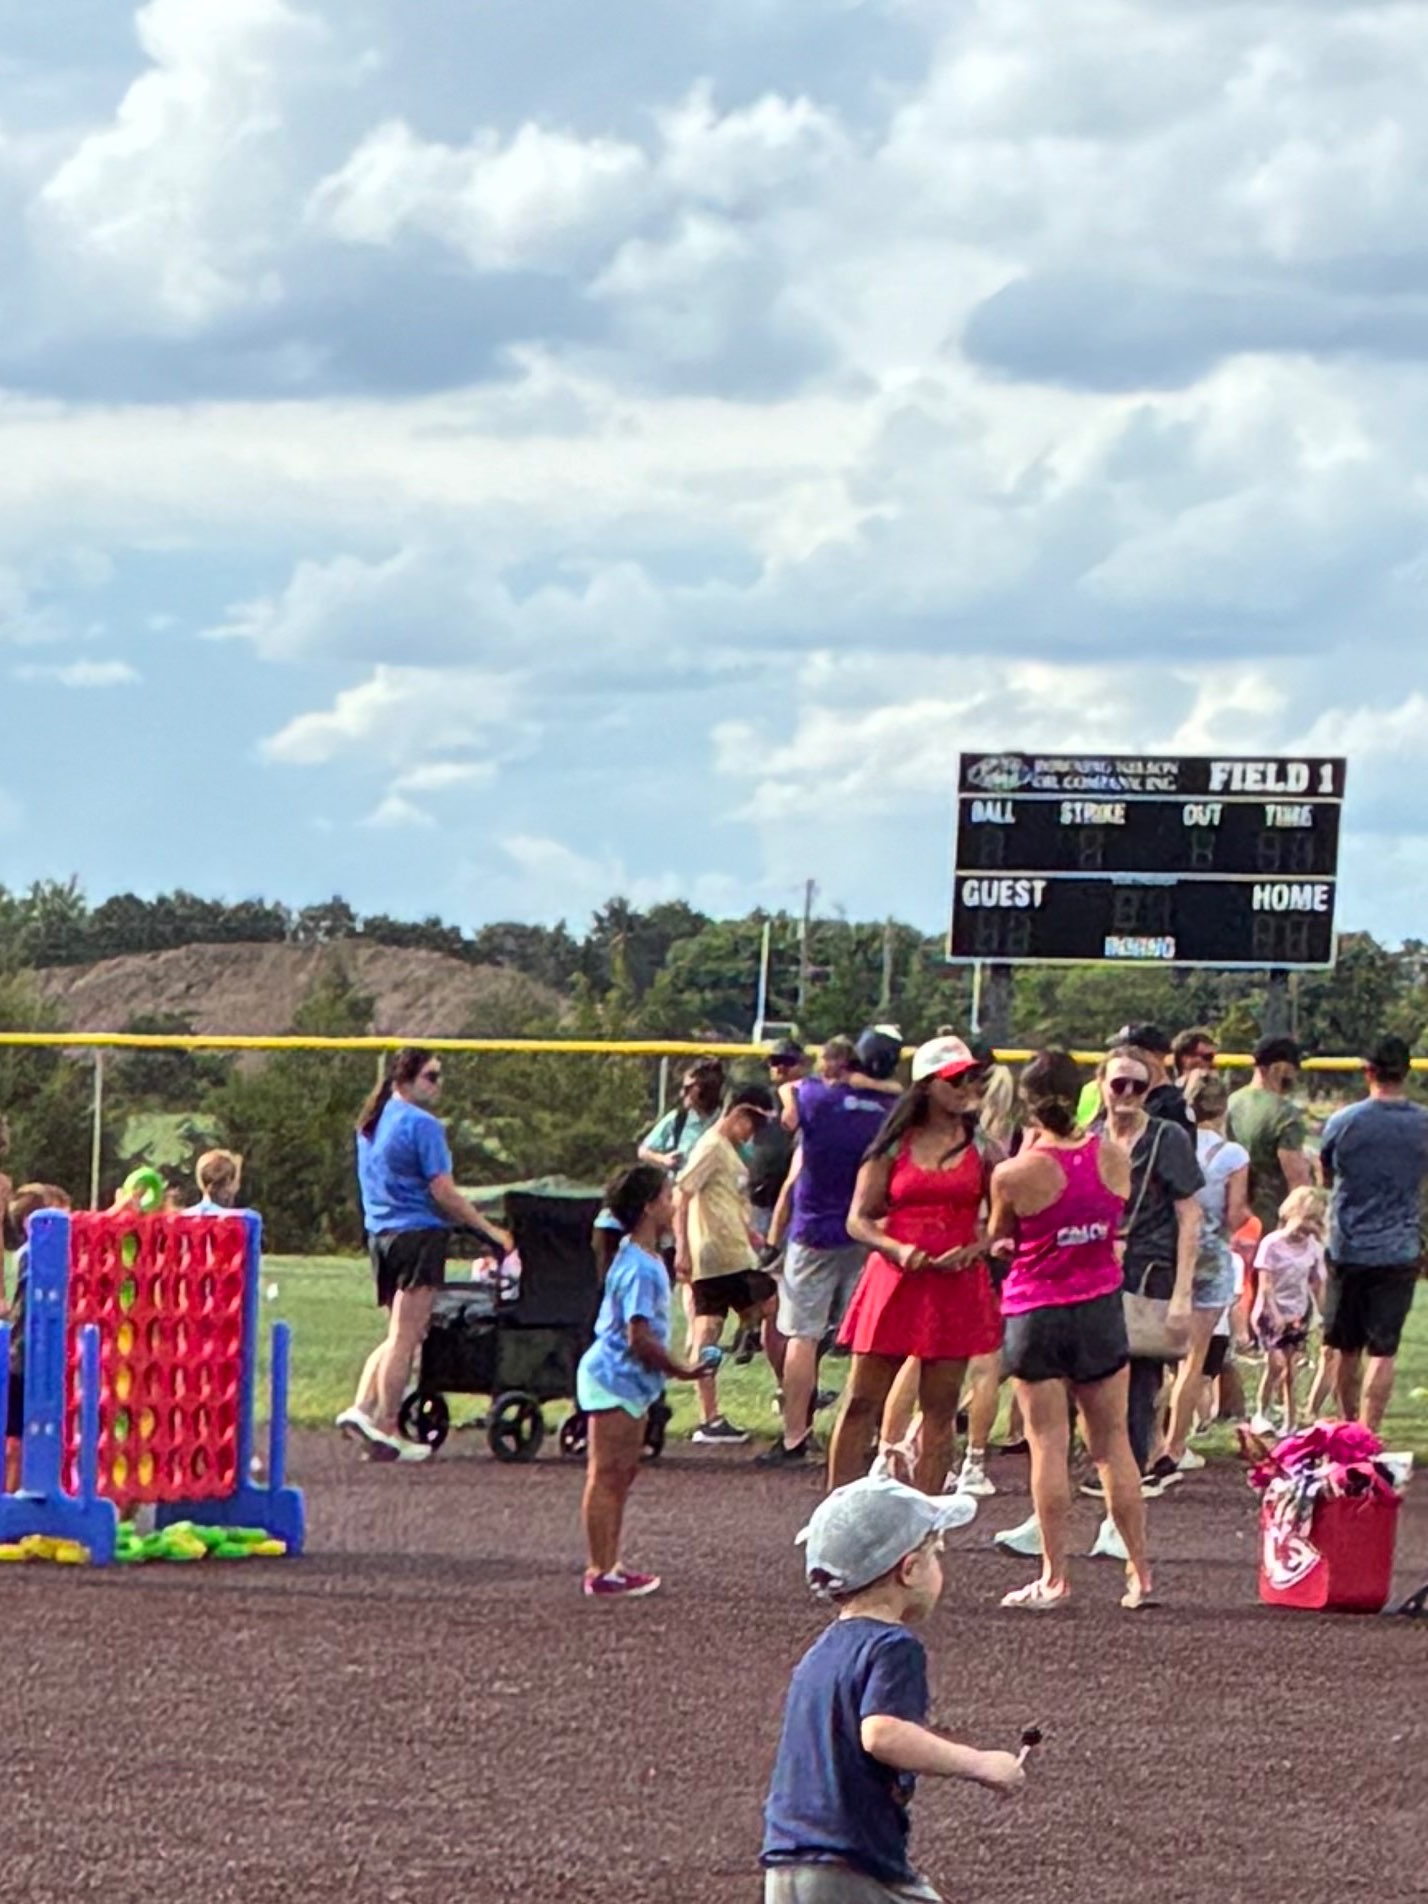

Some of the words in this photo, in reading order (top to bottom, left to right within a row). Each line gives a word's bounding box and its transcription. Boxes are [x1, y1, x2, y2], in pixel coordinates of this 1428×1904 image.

[1208, 761, 1309, 793] FIELD
[1318, 762, 1333, 793] 1
[971, 800, 1016, 823] BALL
[1060, 801, 1126, 824] STRIKE
[1182, 802, 1222, 826] OUT
[1265, 803, 1313, 827] TIME
[961, 879, 1047, 907] GUEST
[1252, 883, 1329, 912] HOME
